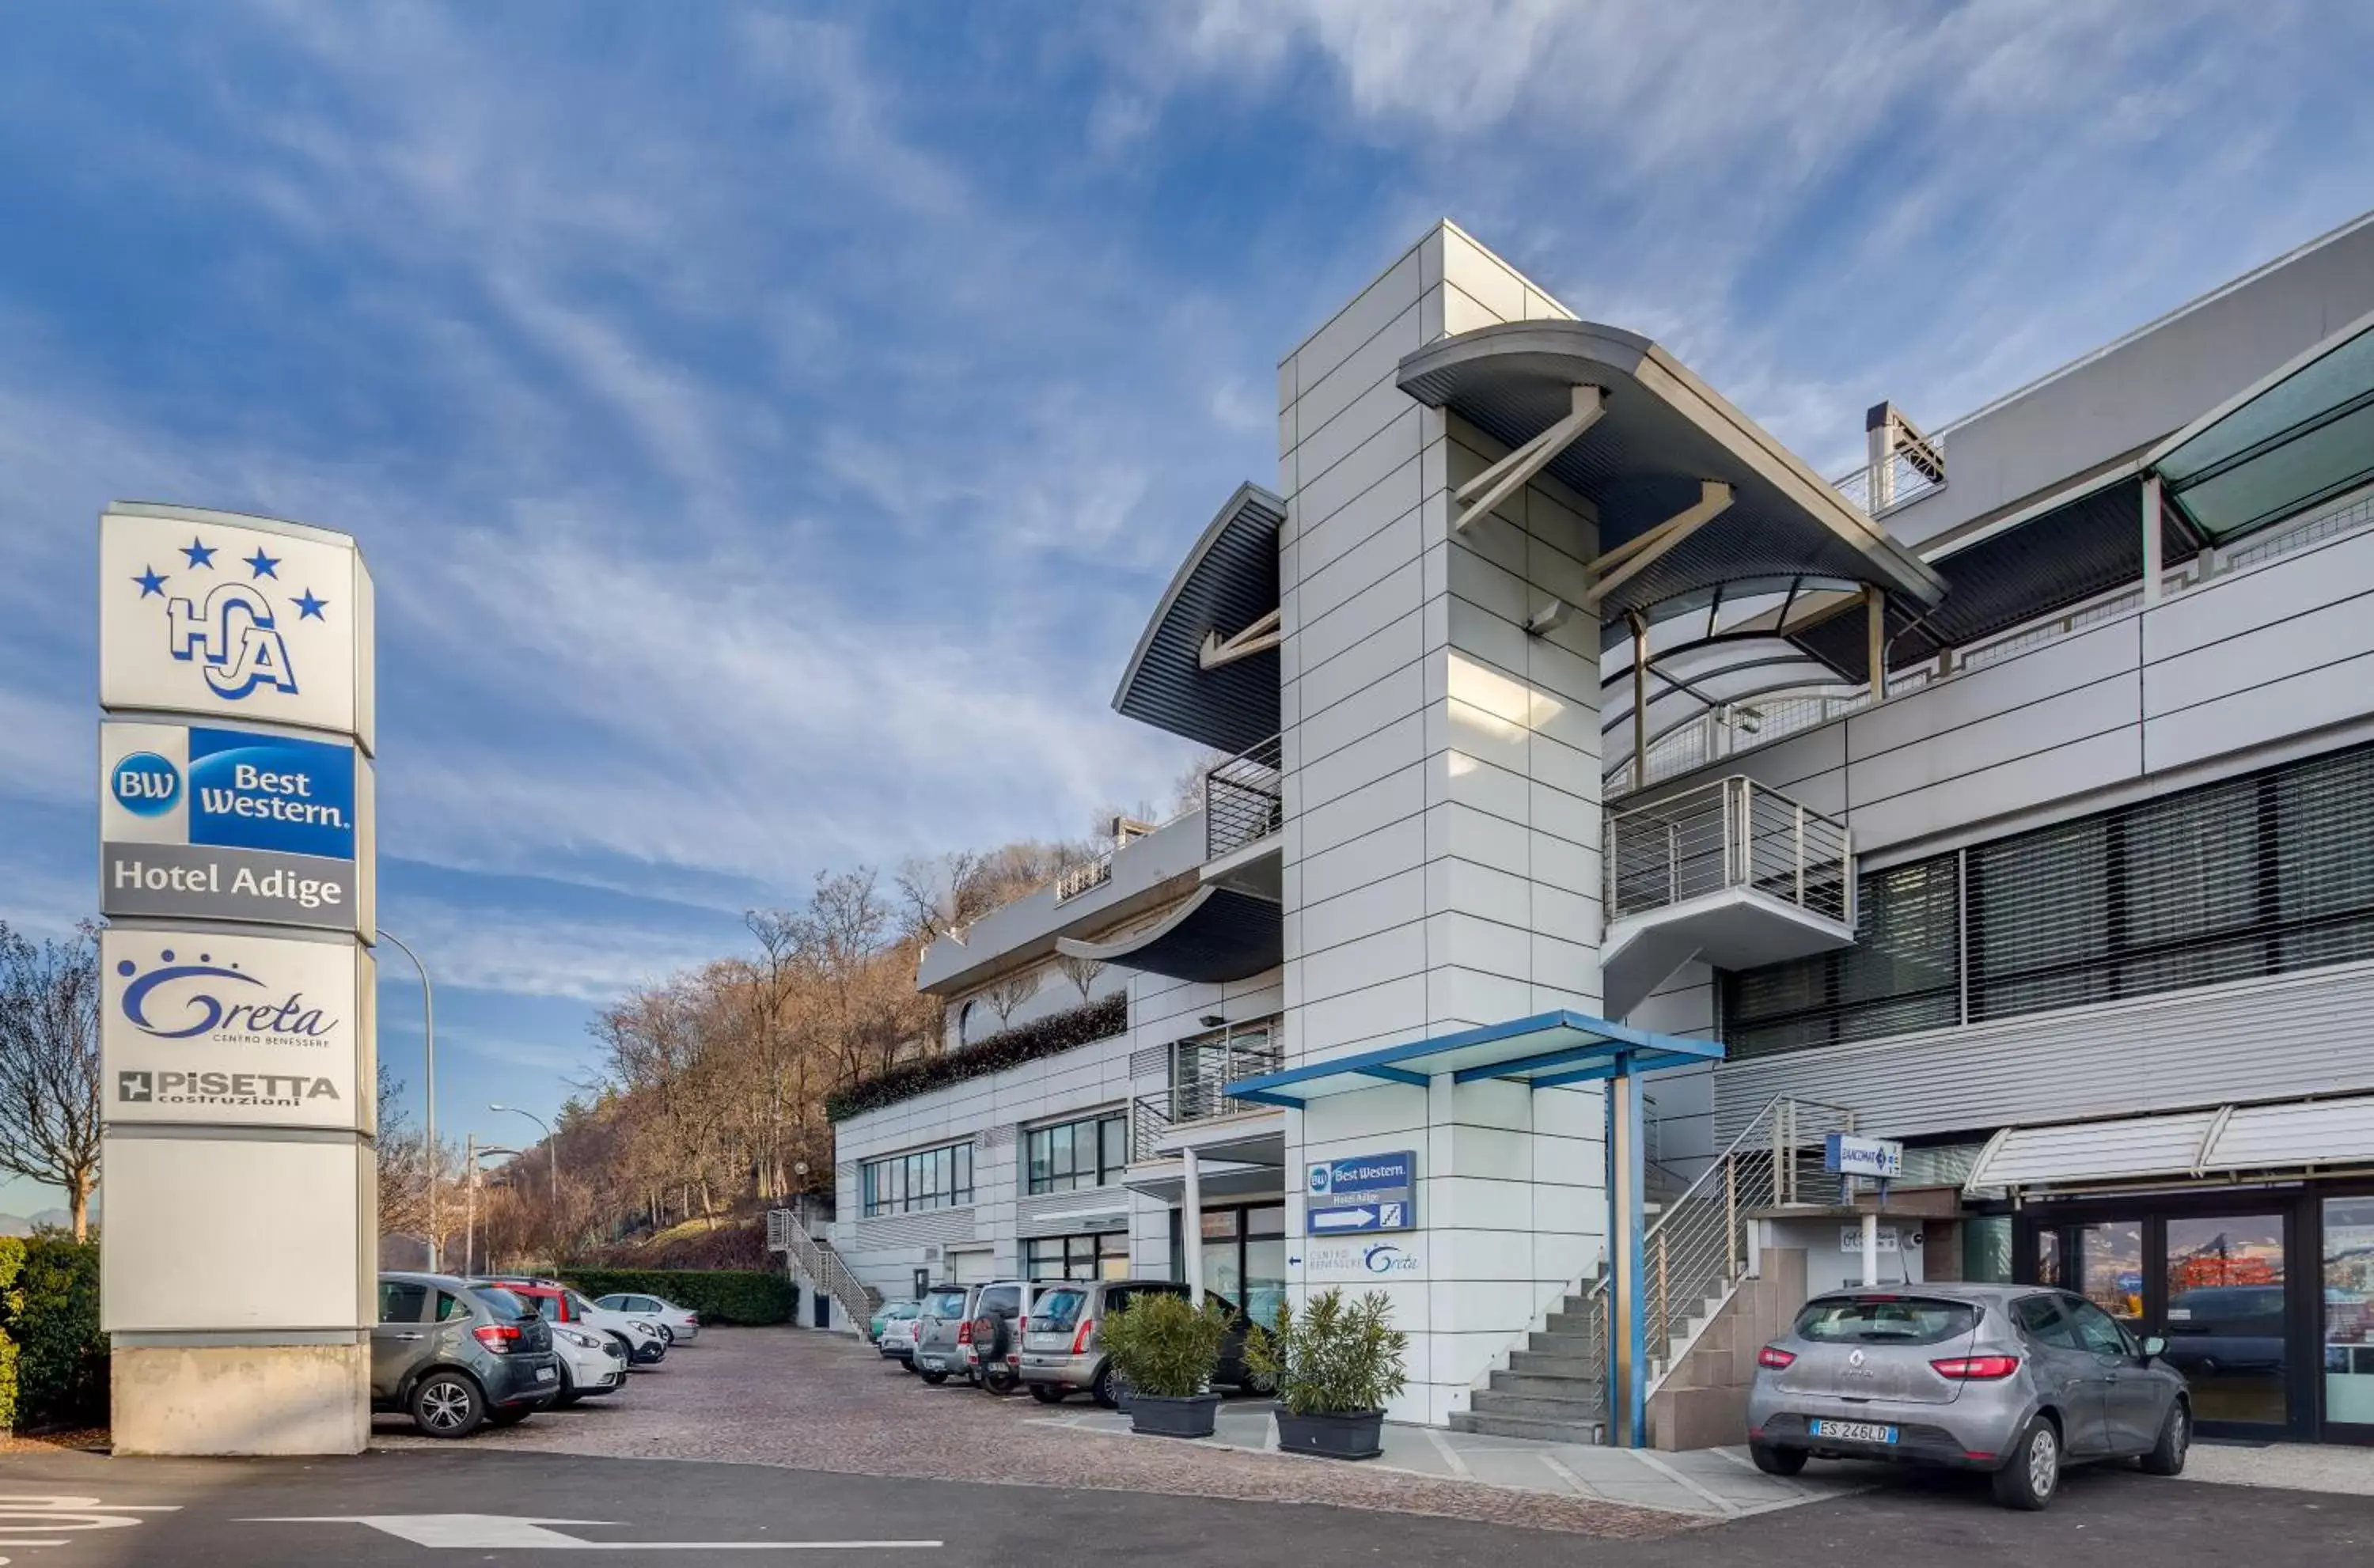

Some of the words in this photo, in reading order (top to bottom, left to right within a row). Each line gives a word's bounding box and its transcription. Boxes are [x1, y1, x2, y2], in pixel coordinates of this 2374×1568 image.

[119, 771, 175, 798] BW
[235, 763, 311, 797] Best
[114, 860, 219, 893] Hotel
[231, 868, 342, 907] Adige
[121, 965, 339, 1039] Greta
[212, 1033, 260, 1044] CENTRO
[265, 1036, 330, 1048] BENESSERE
[157, 1095, 301, 1107] costruzioni
[1335, 1170, 1358, 1182] Best
